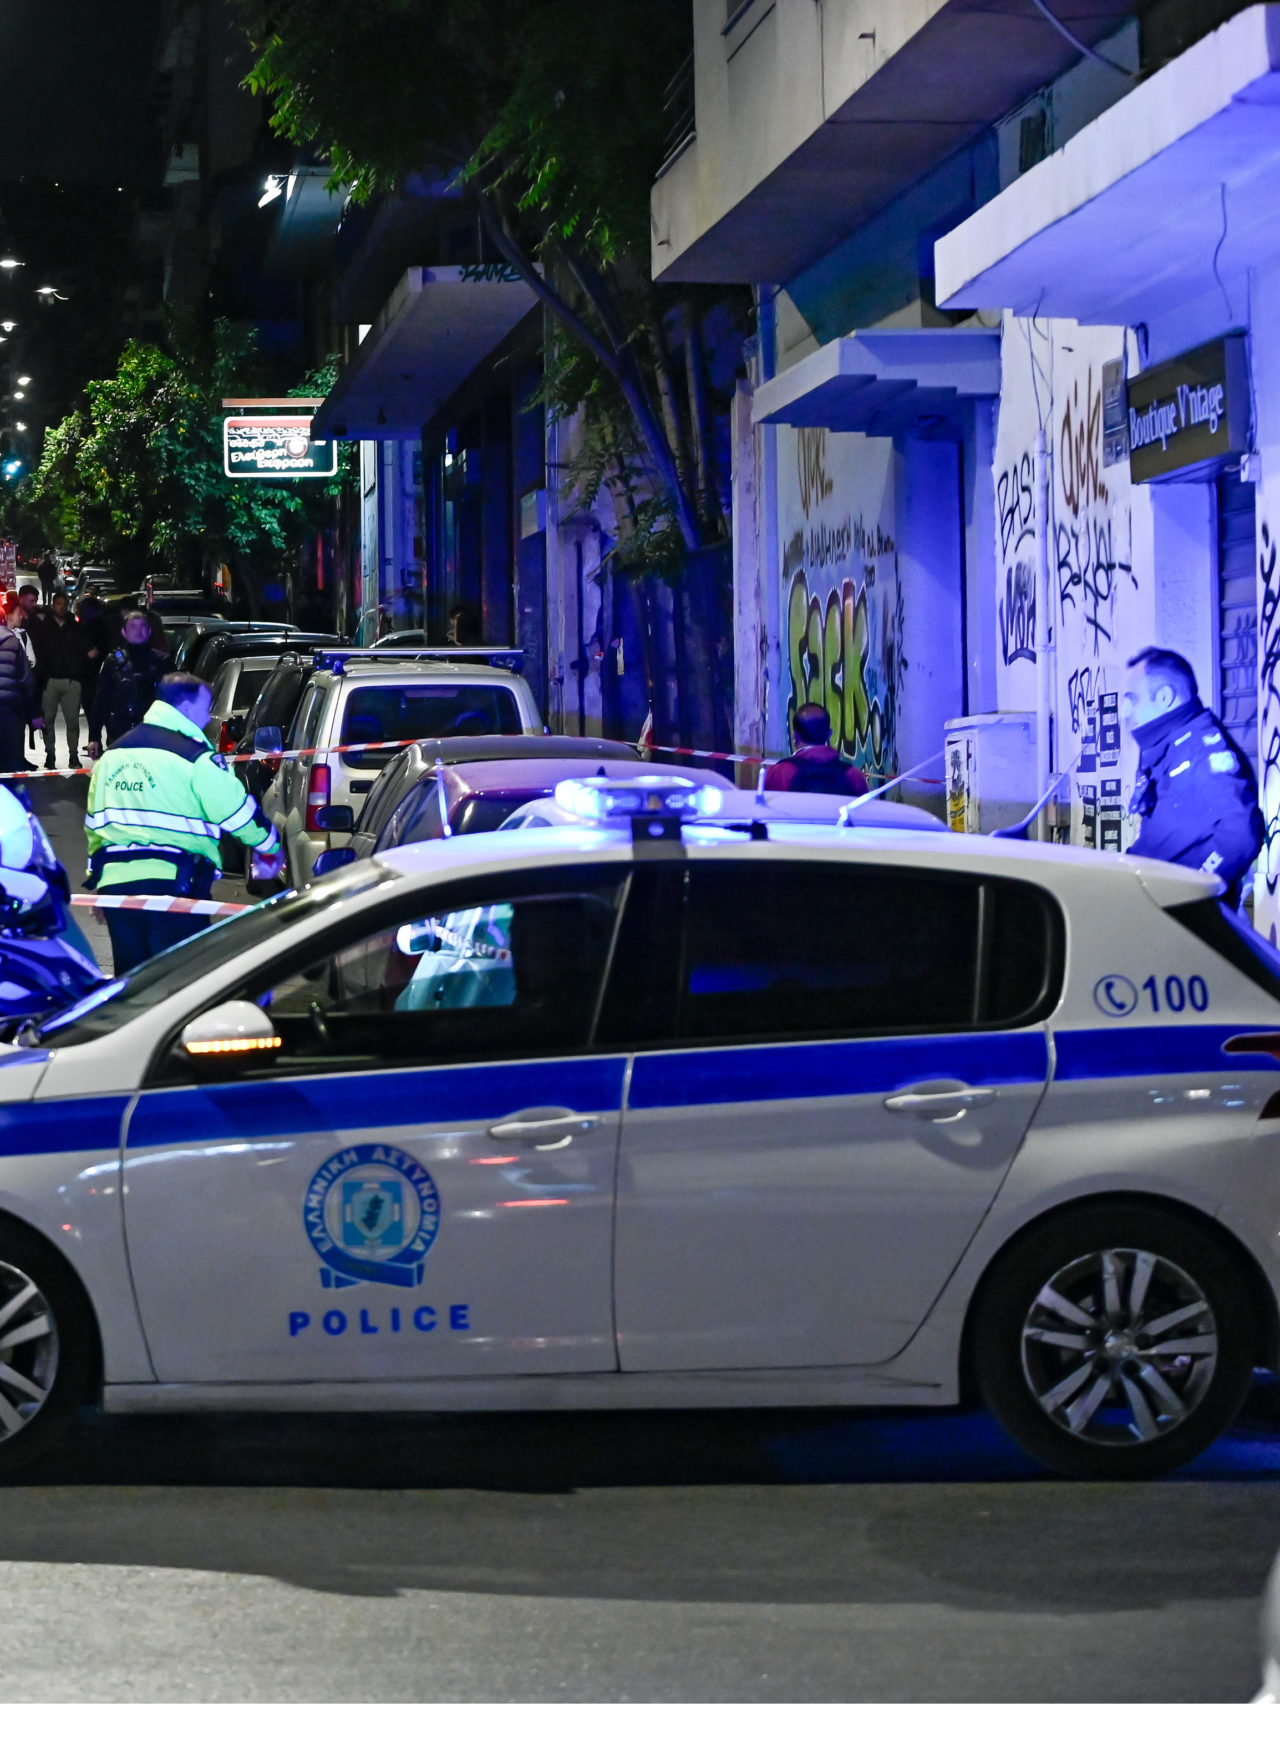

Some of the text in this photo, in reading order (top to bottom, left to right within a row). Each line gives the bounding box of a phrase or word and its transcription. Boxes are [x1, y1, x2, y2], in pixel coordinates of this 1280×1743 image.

[1129, 396, 1178, 451] Boutique
[115, 781, 143, 792] POLICE
[1143, 975, 1208, 1012] 100
[289, 1304, 470, 1336] POLICE
